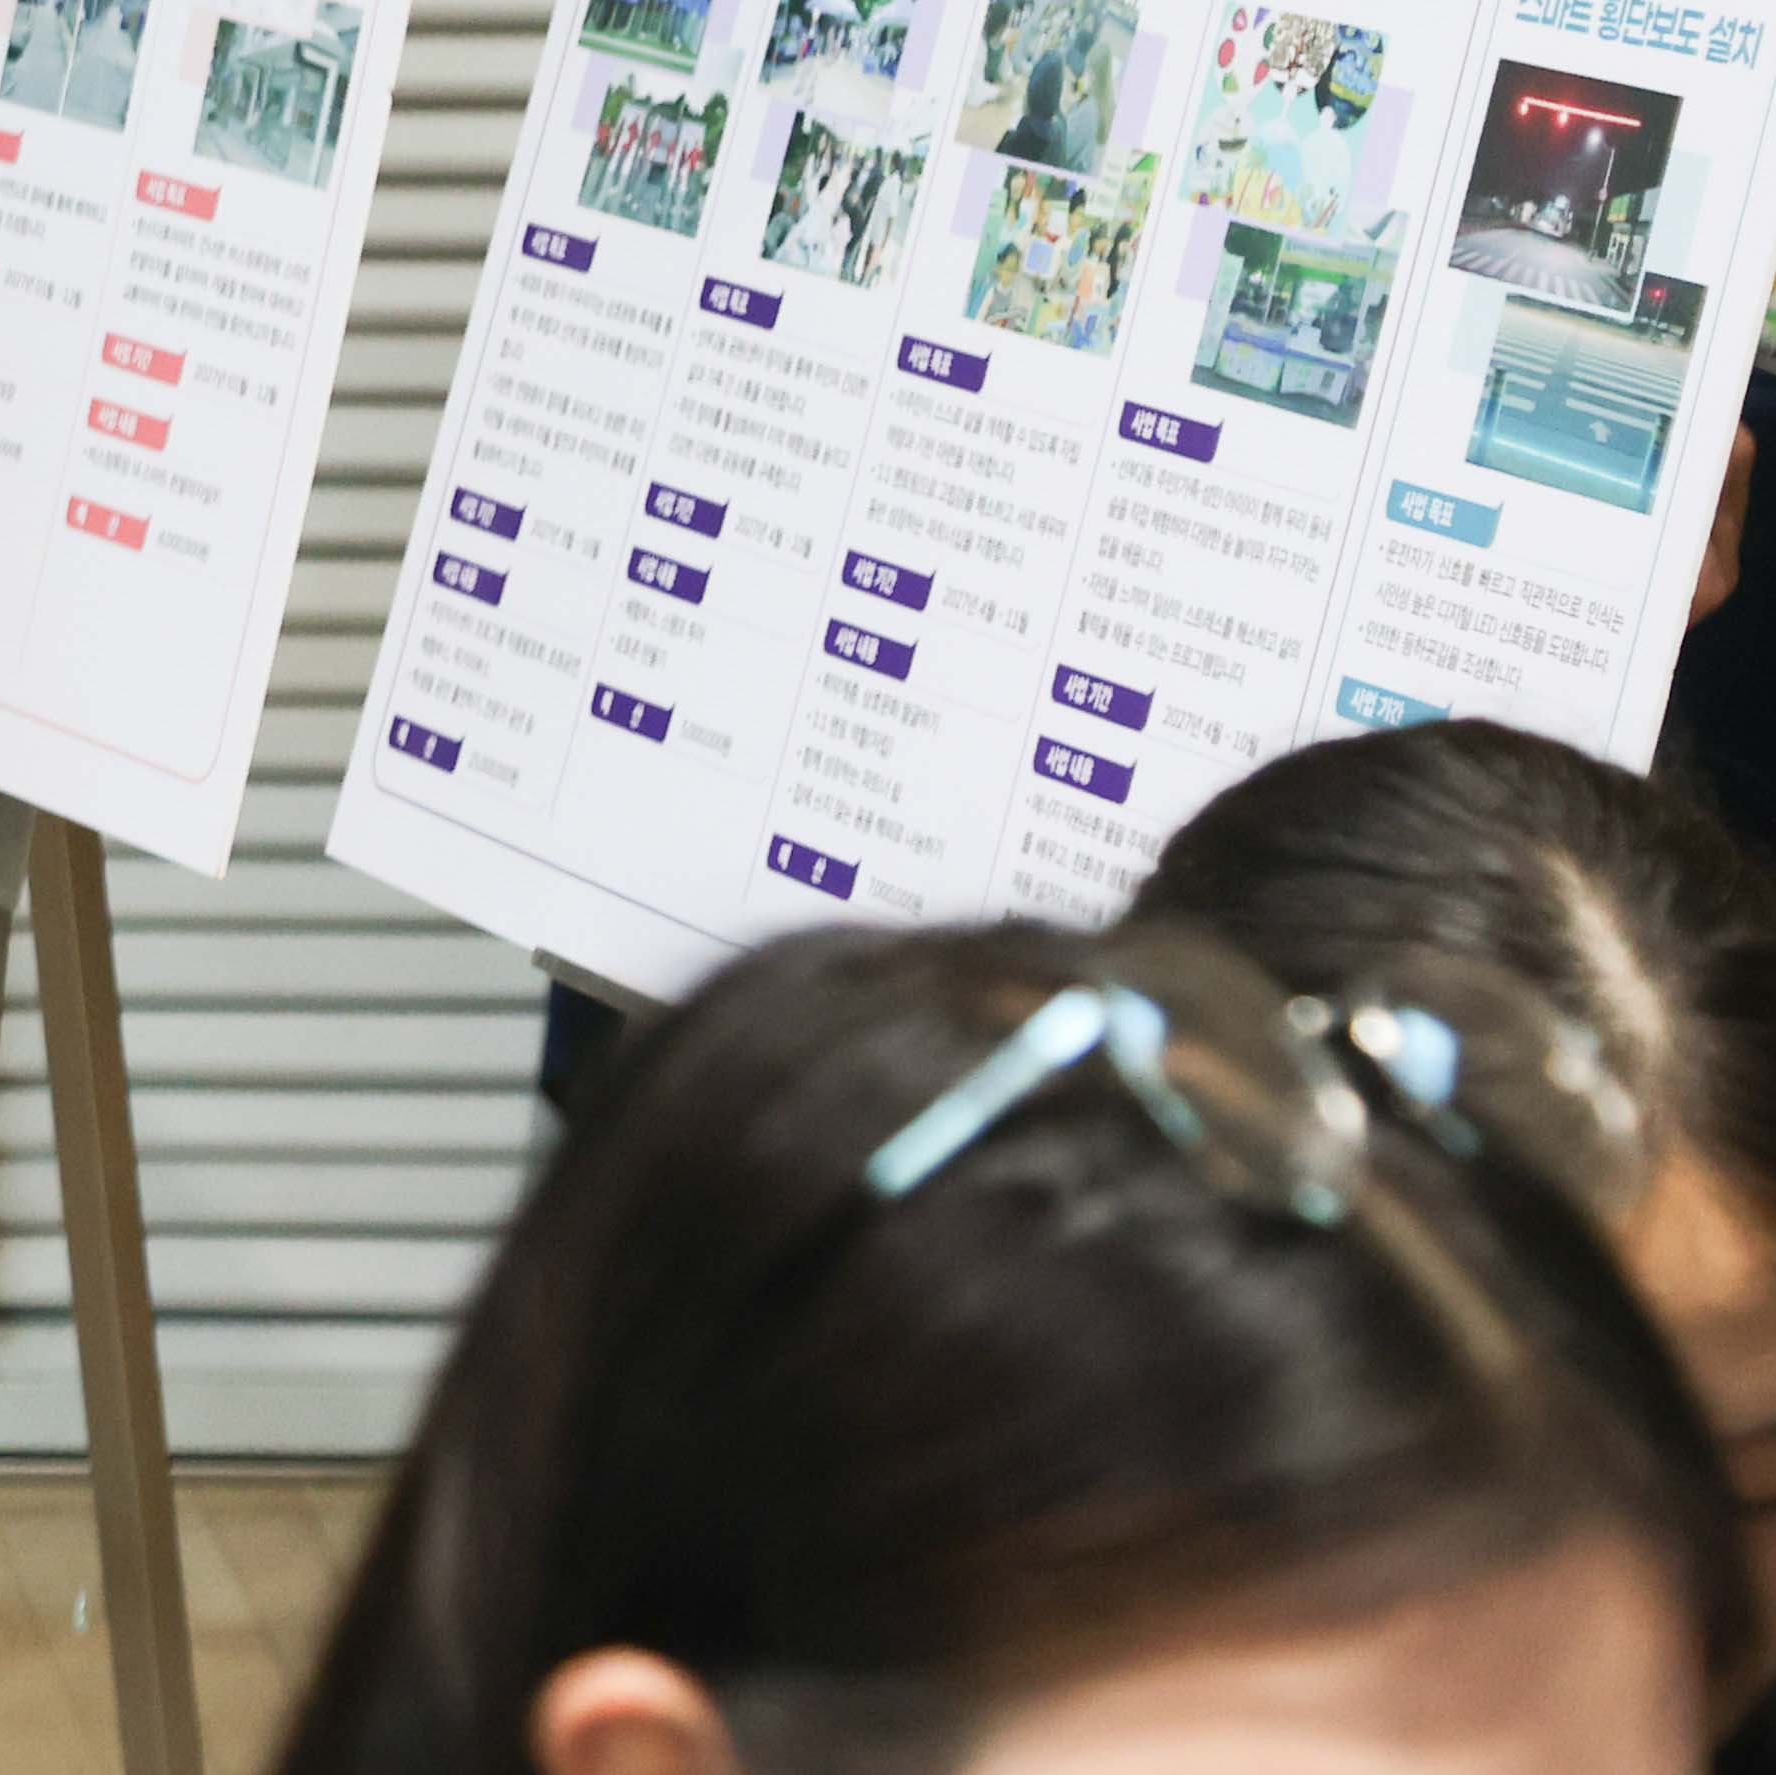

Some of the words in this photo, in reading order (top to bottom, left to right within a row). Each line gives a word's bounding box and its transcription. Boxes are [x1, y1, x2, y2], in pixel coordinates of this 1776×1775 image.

[1705, 14, 1765, 70] 설치
[1400, 490, 1429, 522] 사업
[1428, 497, 1456, 528] 목표
[1385, 538, 1434, 574] 운전자가
[1437, 556, 1476, 587] 신호를
[1478, 568, 1516, 598] 빠르고
[1520, 579, 1583, 619] 직관적으로
[1350, 686, 1378, 719] 사업
[1375, 695, 1406, 726] 기간
